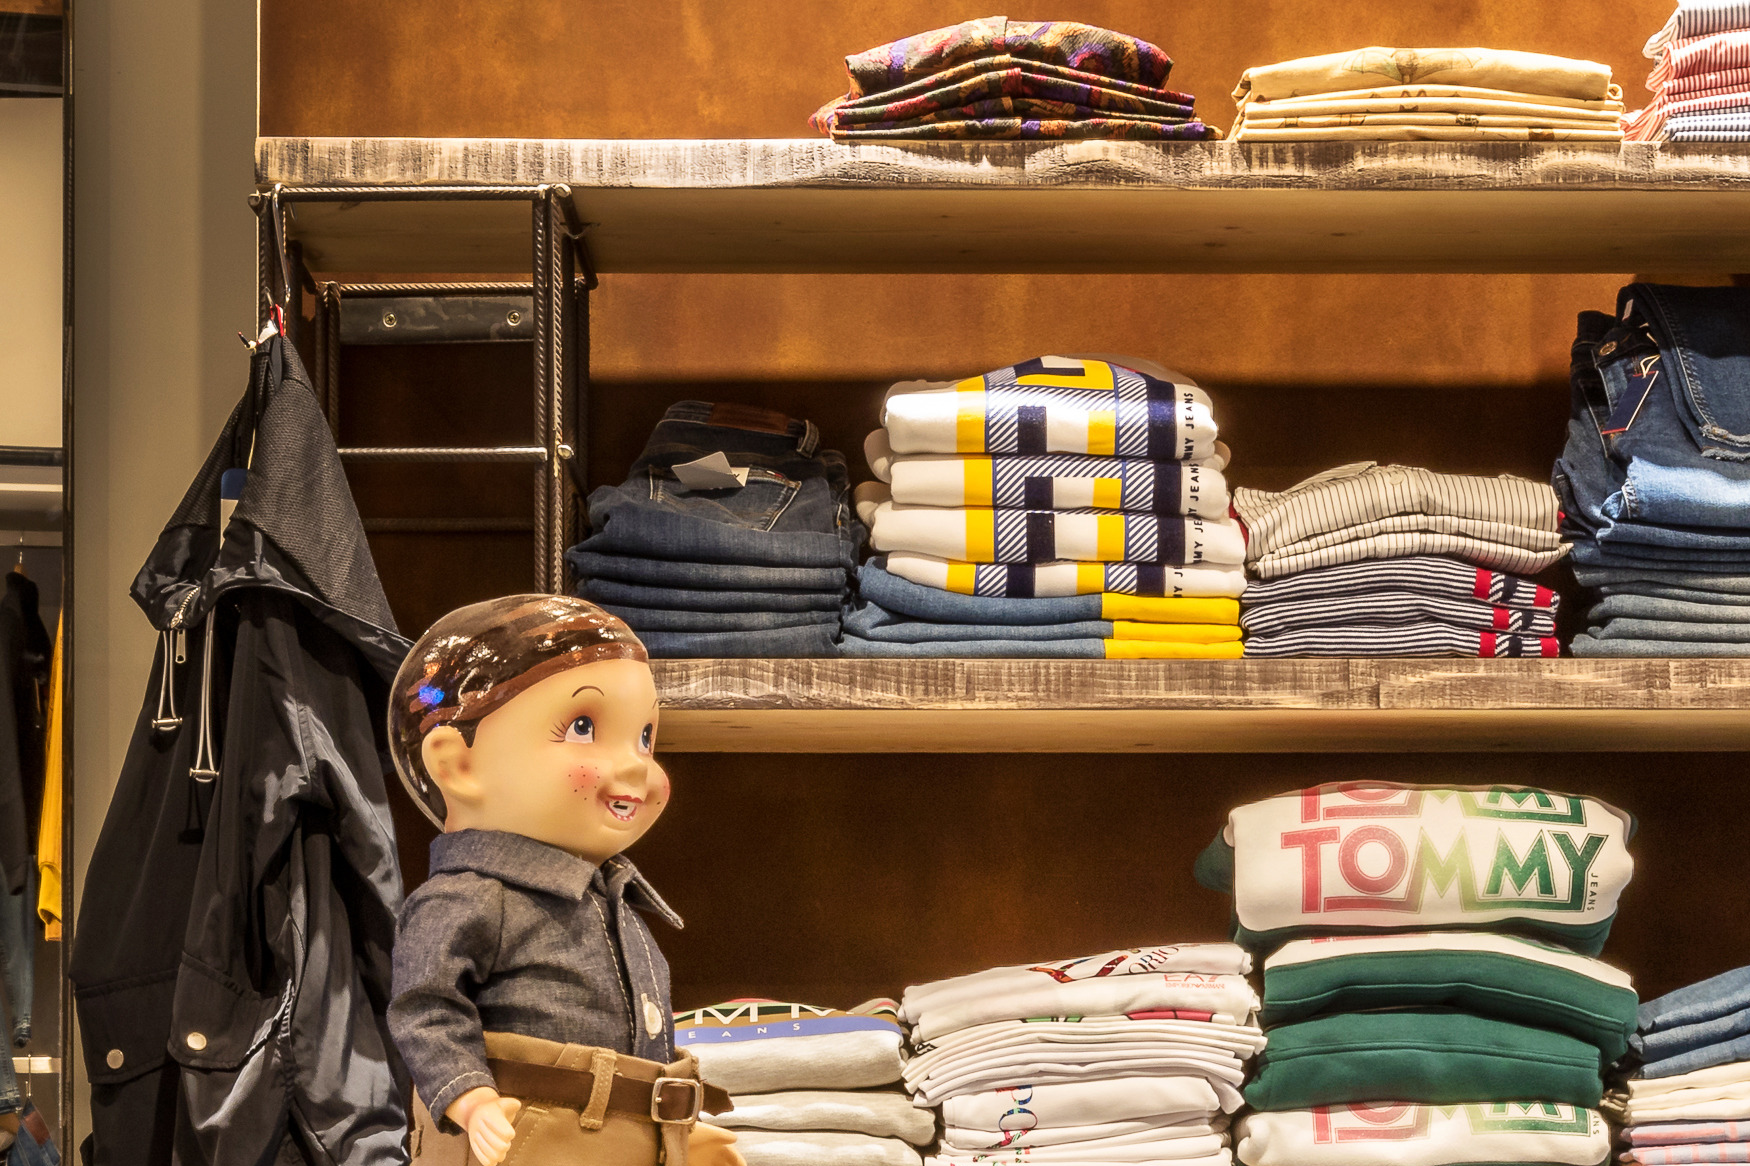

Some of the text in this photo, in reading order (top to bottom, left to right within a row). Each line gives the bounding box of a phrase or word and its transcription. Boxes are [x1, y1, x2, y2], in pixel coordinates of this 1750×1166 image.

[1184, 392, 1194, 430] JEANS
[1189, 463, 1199, 501] JEANS
[1281, 825, 1609, 914] TOMMY
[1586, 872, 1599, 911] JEANS
[688, 1022, 801, 1040] EANS
